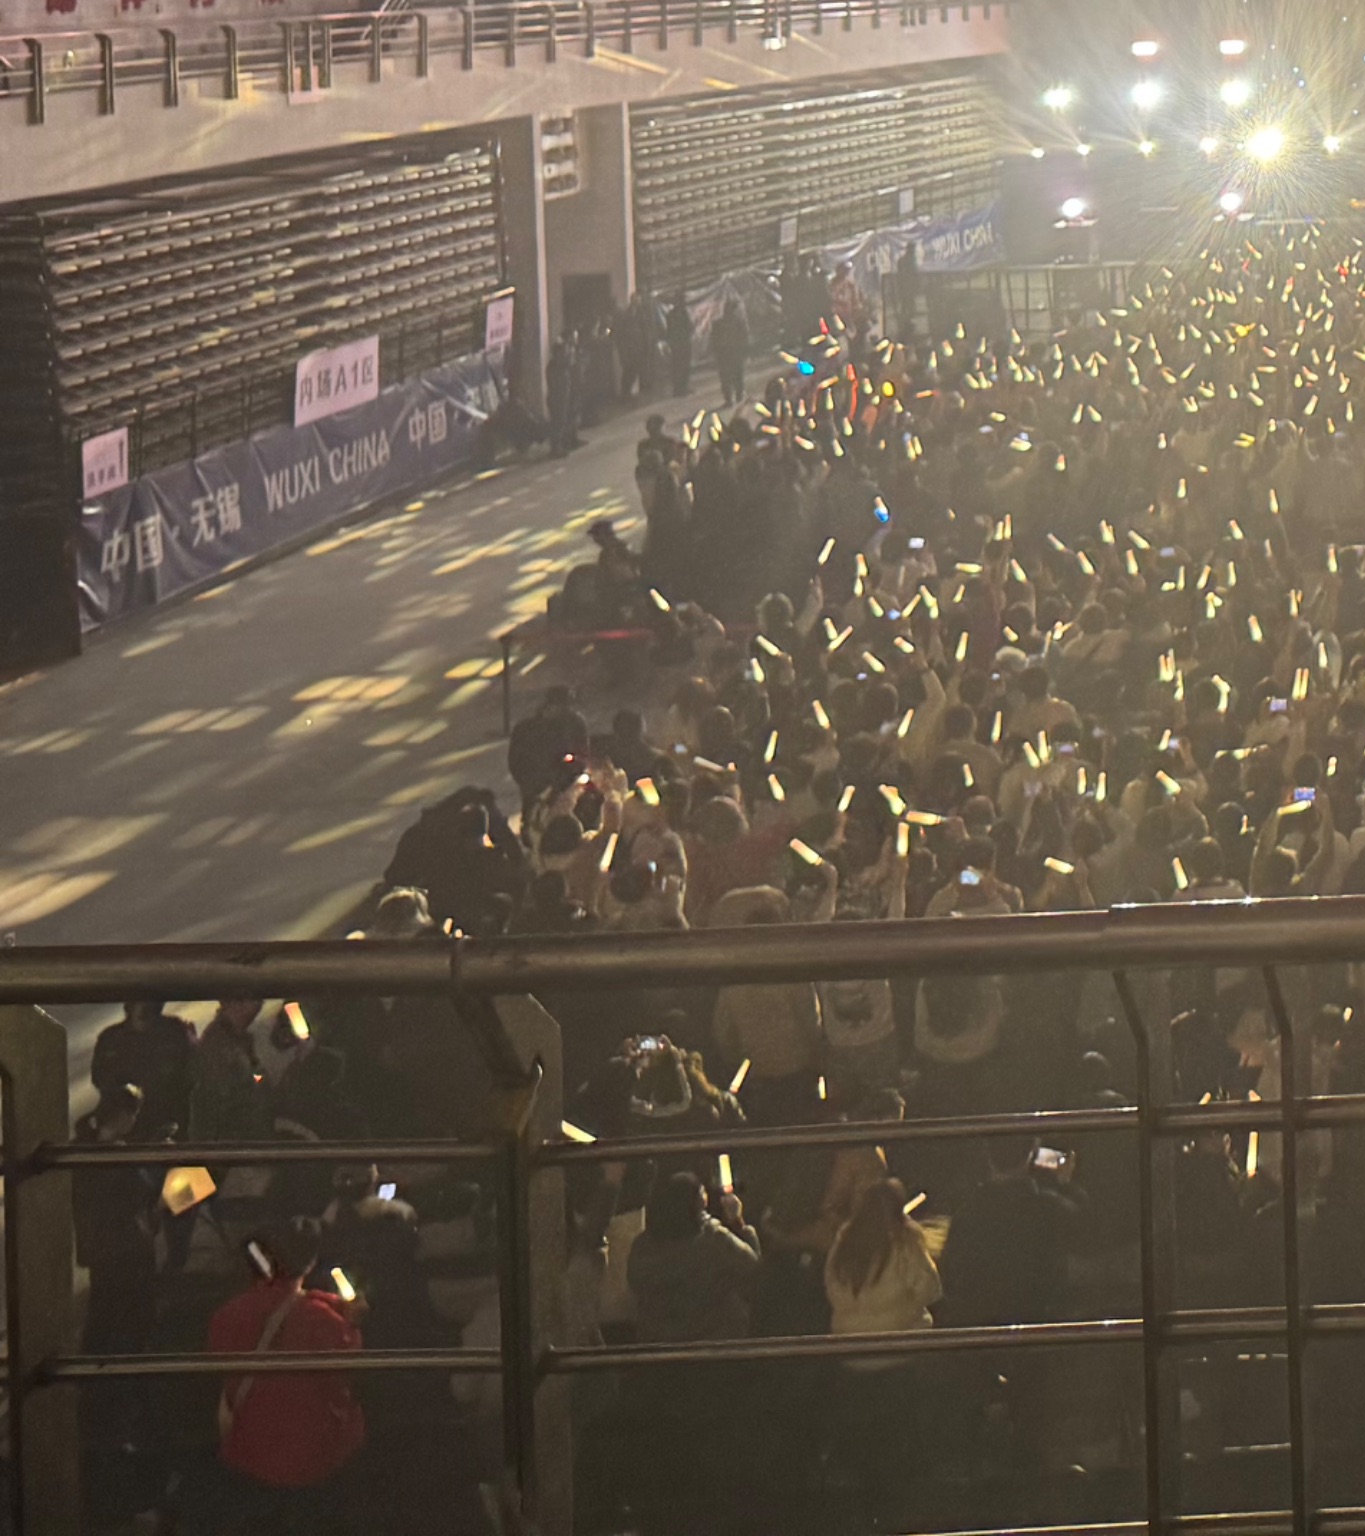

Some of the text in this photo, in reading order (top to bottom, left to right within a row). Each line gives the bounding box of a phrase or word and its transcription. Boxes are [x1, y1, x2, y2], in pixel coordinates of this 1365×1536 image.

[300, 354, 375, 407] 内场A1区
[264, 459, 321, 513] WUXI
[329, 428, 391, 485] CHINA
